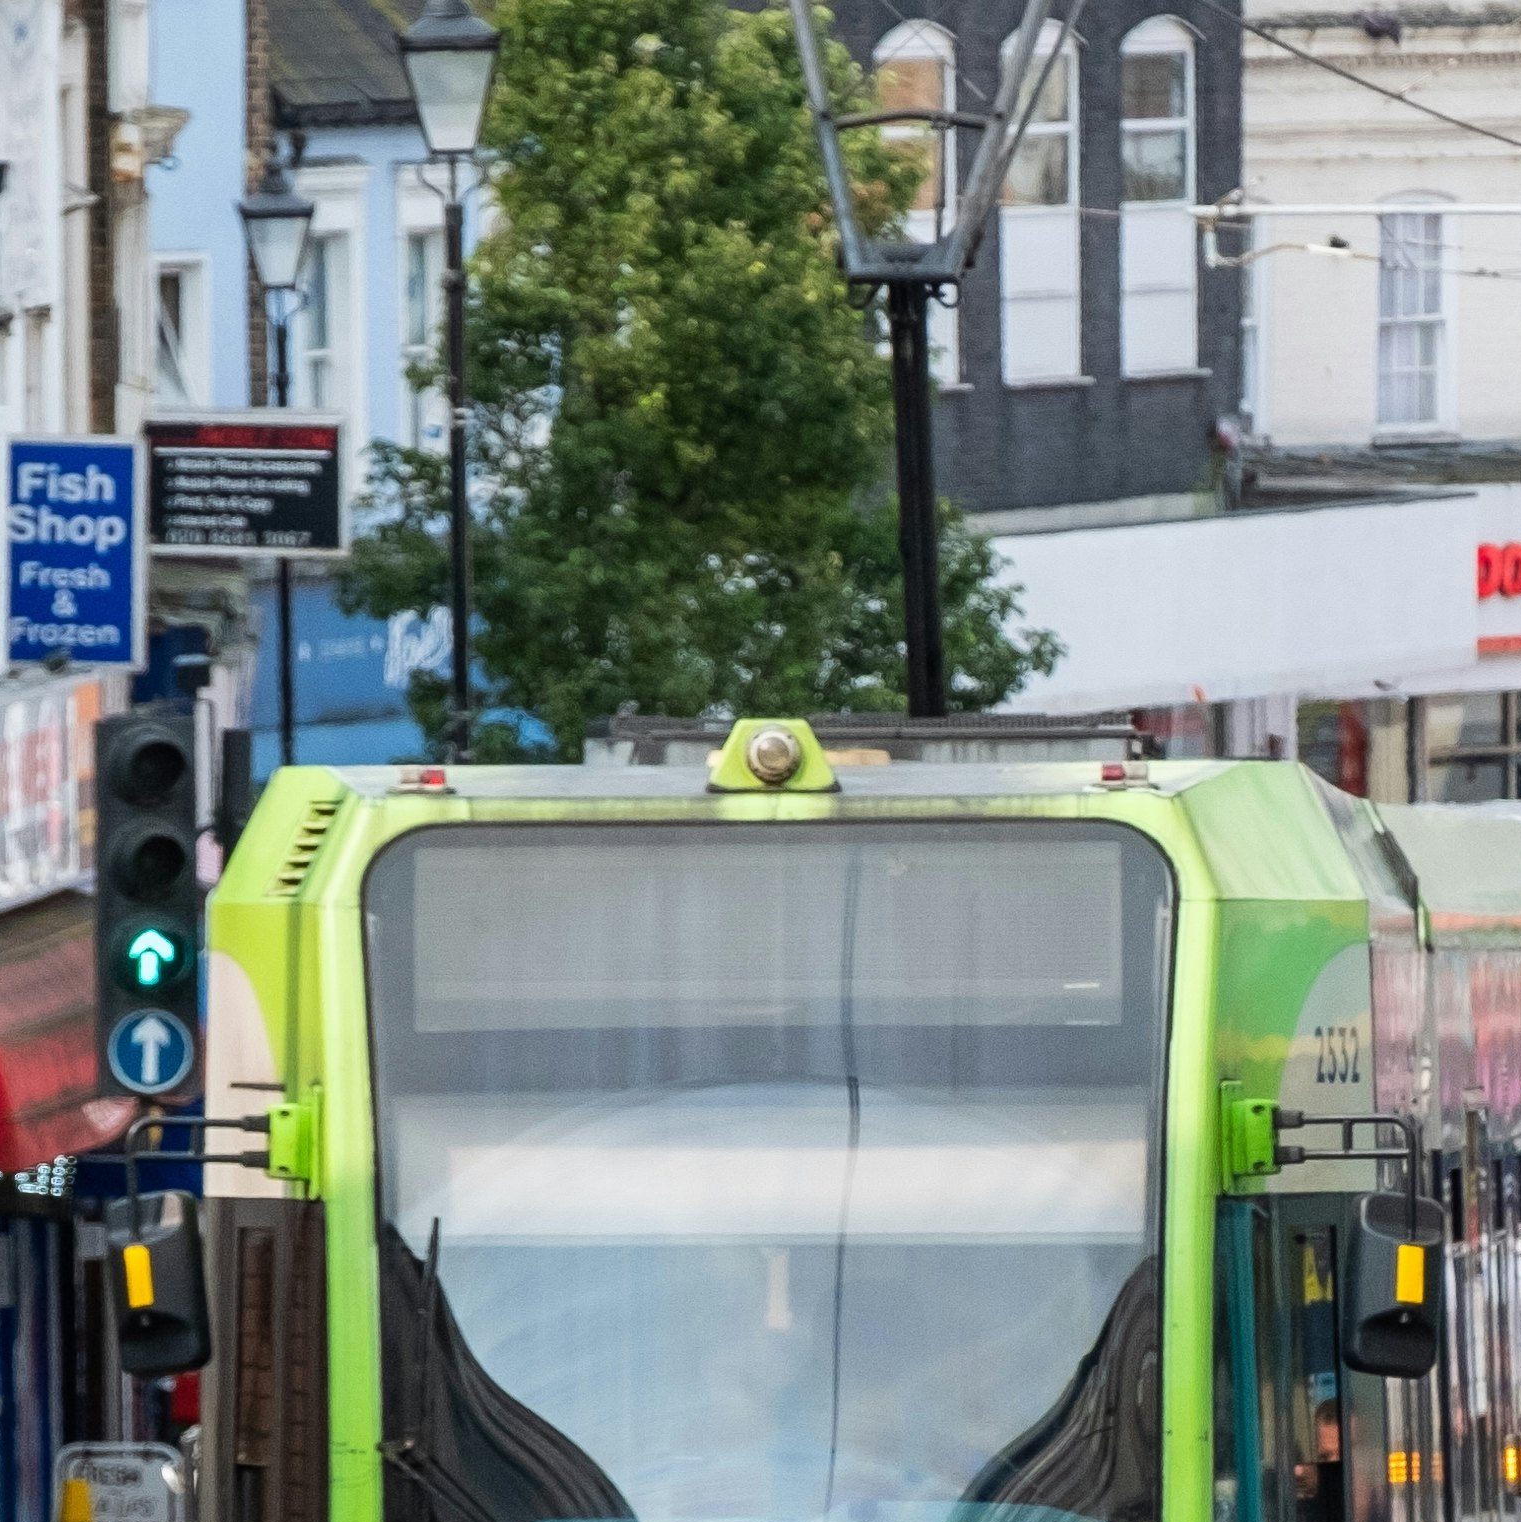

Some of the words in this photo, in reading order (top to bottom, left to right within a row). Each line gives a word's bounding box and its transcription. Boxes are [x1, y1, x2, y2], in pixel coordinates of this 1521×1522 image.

[17, 463, 117, 503] Fish
[8, 503, 128, 553] Shop
[19, 560, 111, 590] Fresh
[50, 590, 78, 619] &
[9, 620, 122, 648] Frozen
[1314, 1025, 1360, 1084] 2532
